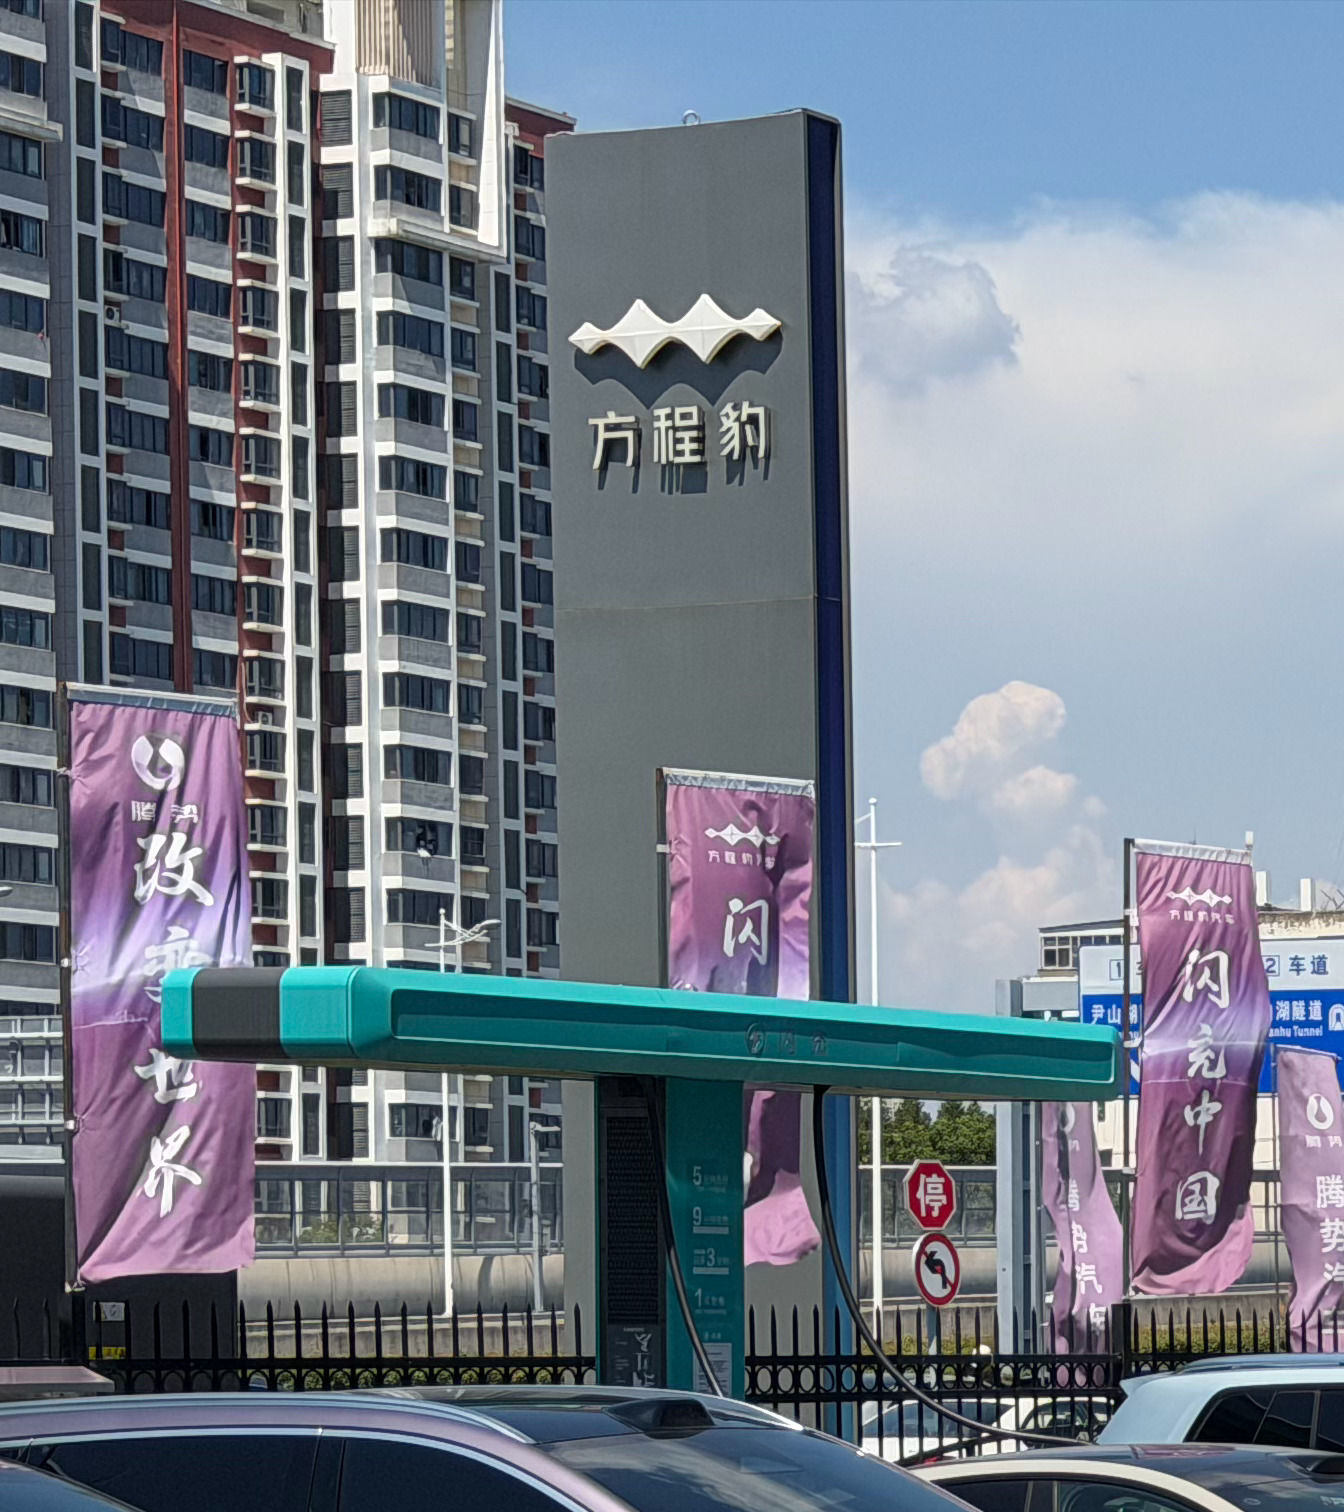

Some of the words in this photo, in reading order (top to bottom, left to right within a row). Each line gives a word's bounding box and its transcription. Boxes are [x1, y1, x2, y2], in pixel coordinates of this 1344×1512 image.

[588, 401, 766, 469] 方程豹
[1288, 953, 1329, 976] 车道
[1269, 999, 1323, 1021] 湖隧道
[1175, 949, 1230, 1225] 闪充中国
[915, 1173, 947, 1218] 停
